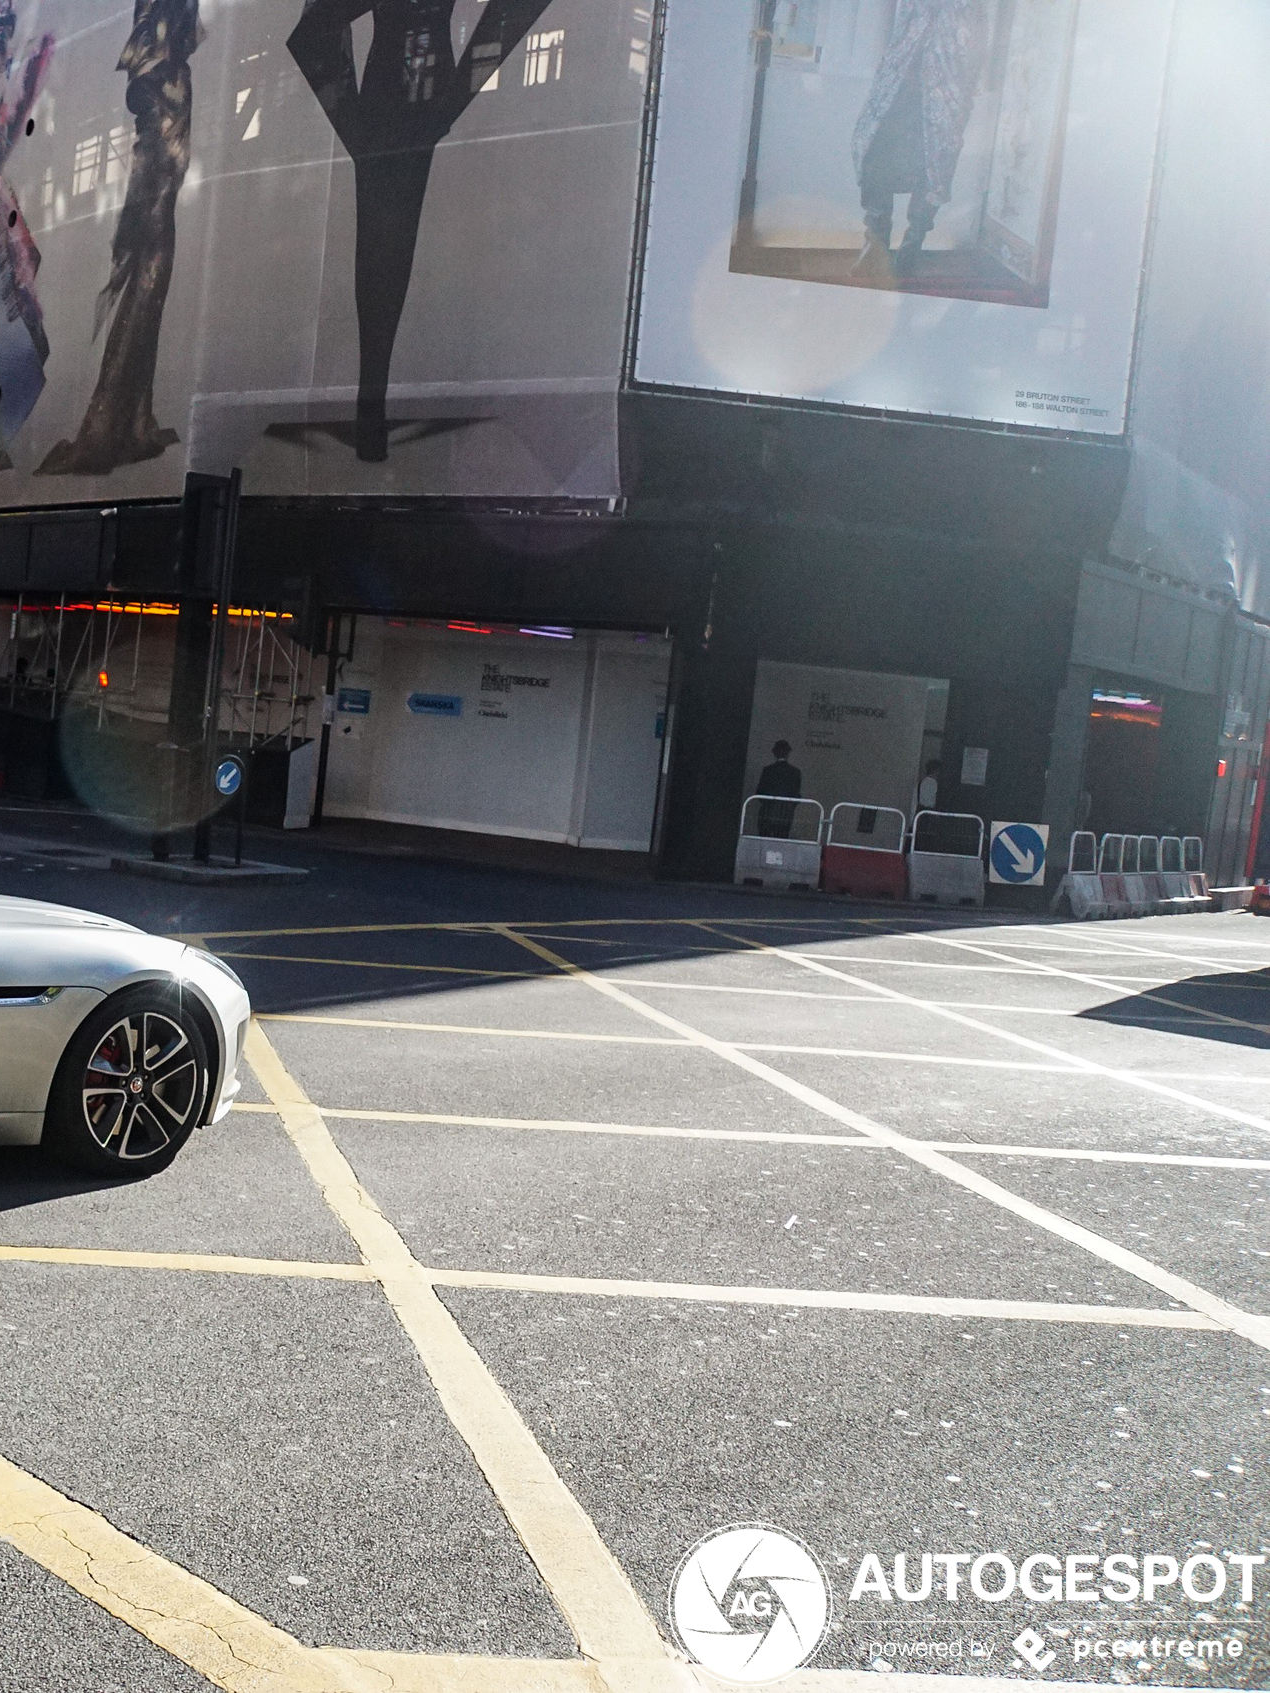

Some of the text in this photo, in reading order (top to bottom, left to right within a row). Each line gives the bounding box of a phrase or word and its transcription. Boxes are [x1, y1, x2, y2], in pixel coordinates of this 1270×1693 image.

[1015, 390, 1091, 405] 29 BRUTON STREET
[1045, 404, 1079, 414] WALTON
[1079, 407, 1110, 418] STREET
[483, 663, 500, 674] THE
[481, 674, 551, 688] KNIGHTSBRIDGE
[414, 699, 455, 710] SKANSKA
